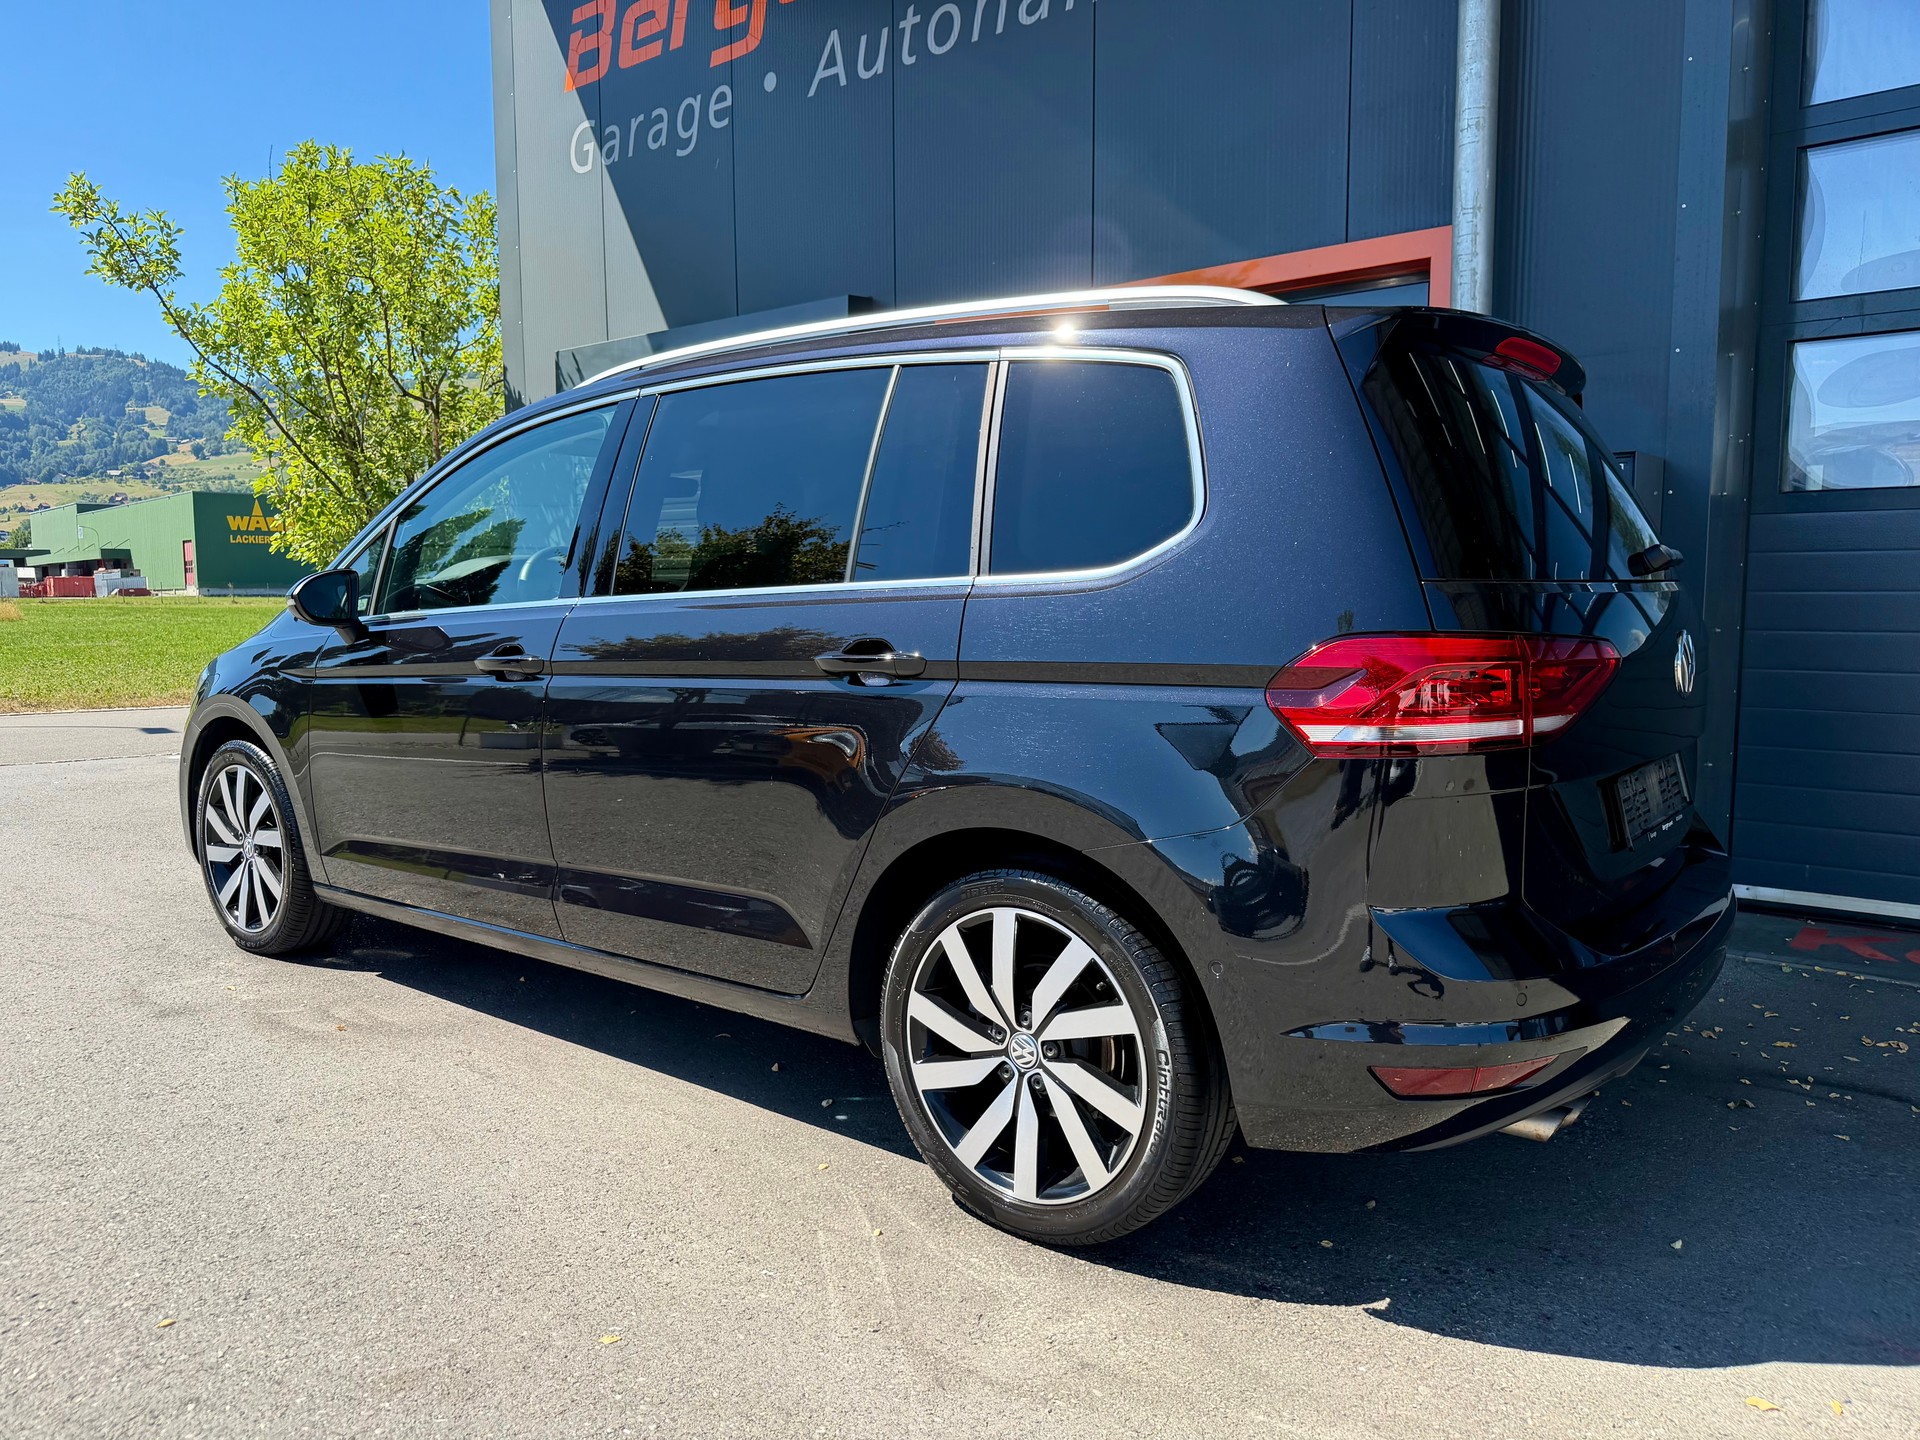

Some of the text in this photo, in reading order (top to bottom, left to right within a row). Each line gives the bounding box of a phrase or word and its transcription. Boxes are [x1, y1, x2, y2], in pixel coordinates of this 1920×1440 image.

[563, 0, 797, 92] Berg
[569, 83, 733, 174] Garage
[230, 534, 272, 544] LACKIER
[1789, 926, 1920, 964] K
[1149, 1048, 1171, 1155] Cinturato
